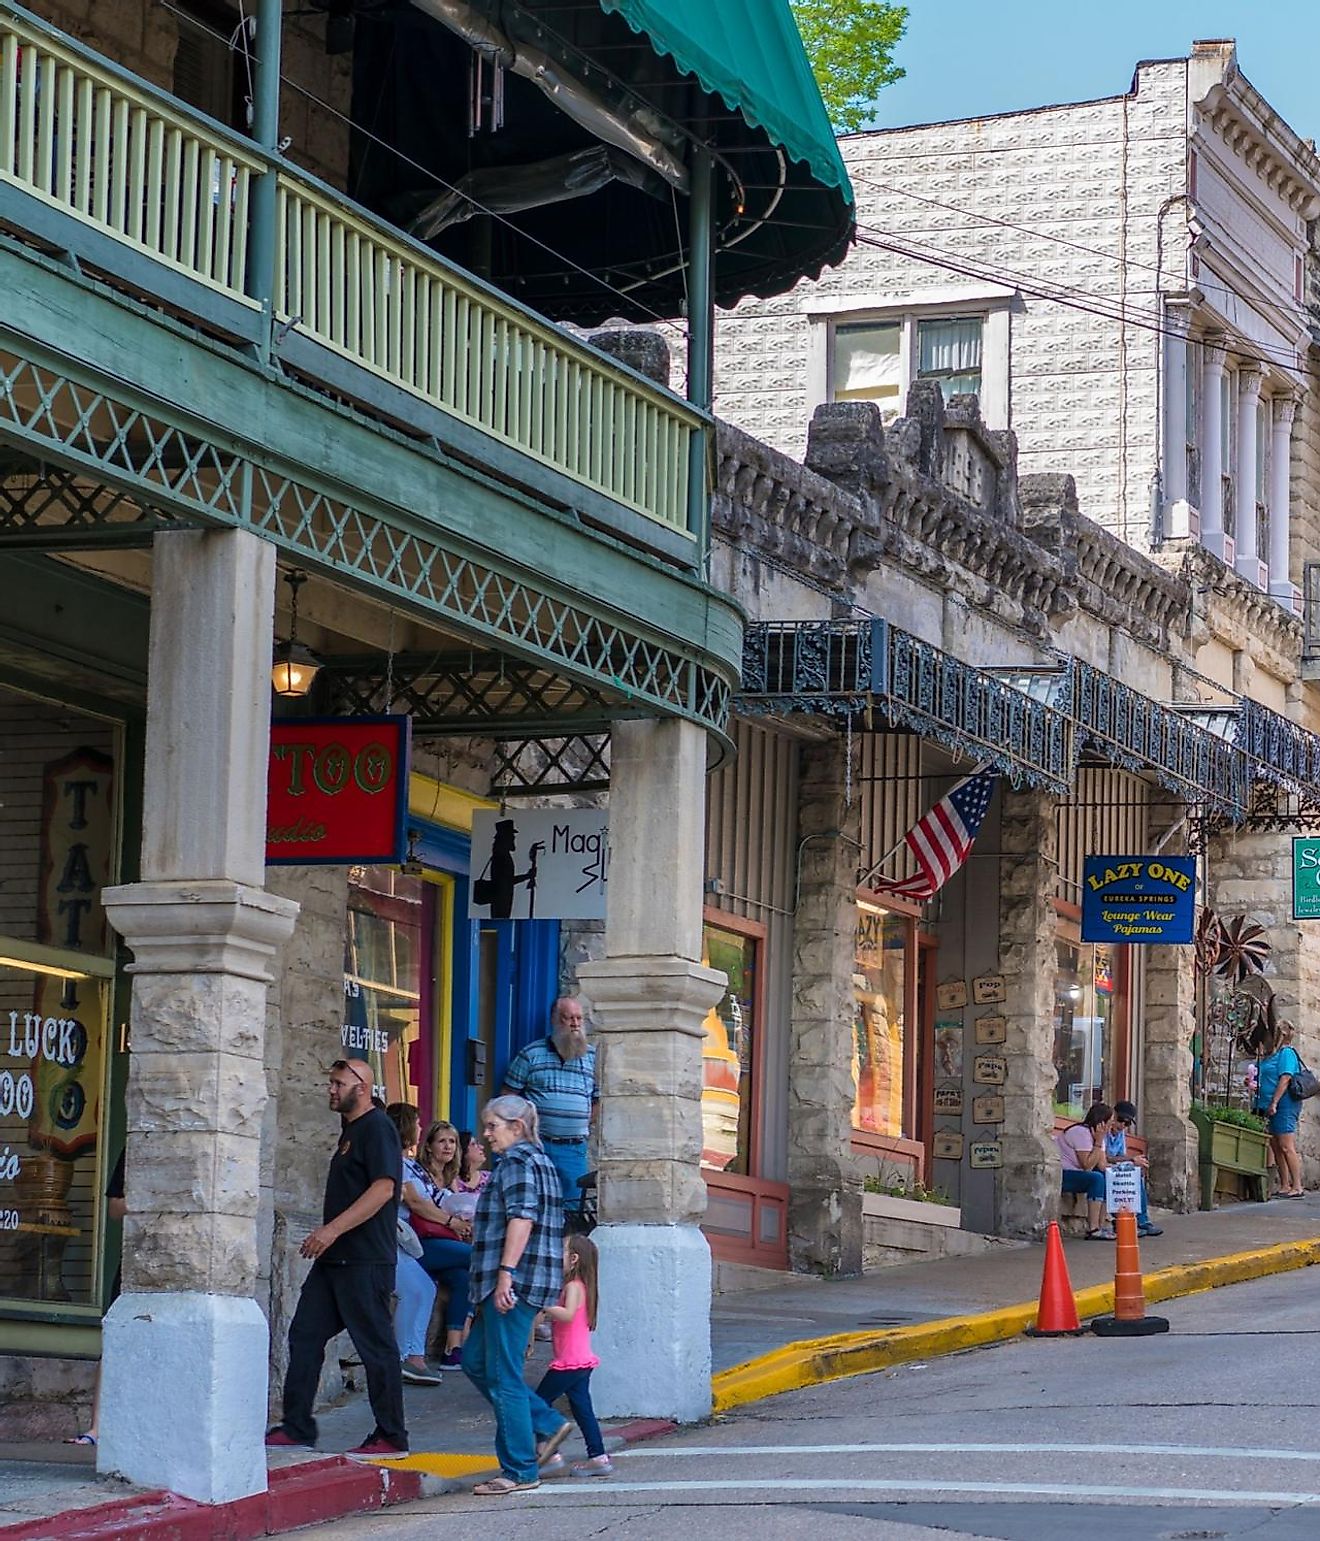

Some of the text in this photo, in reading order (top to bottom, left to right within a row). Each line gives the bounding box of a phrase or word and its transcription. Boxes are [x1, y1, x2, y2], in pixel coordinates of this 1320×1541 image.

[272, 742, 392, 796] TOO
[1088, 863, 1191, 892] LAZY ONE
[1103, 895, 1175, 903] EUREKA SPRINGS
[1102, 910, 1176, 923] Lounge Wear
[1113, 924, 1163, 936] Pajamas
[8, 1010, 76, 1064] LUCK
[0, 1208, 18, 1230] 20
